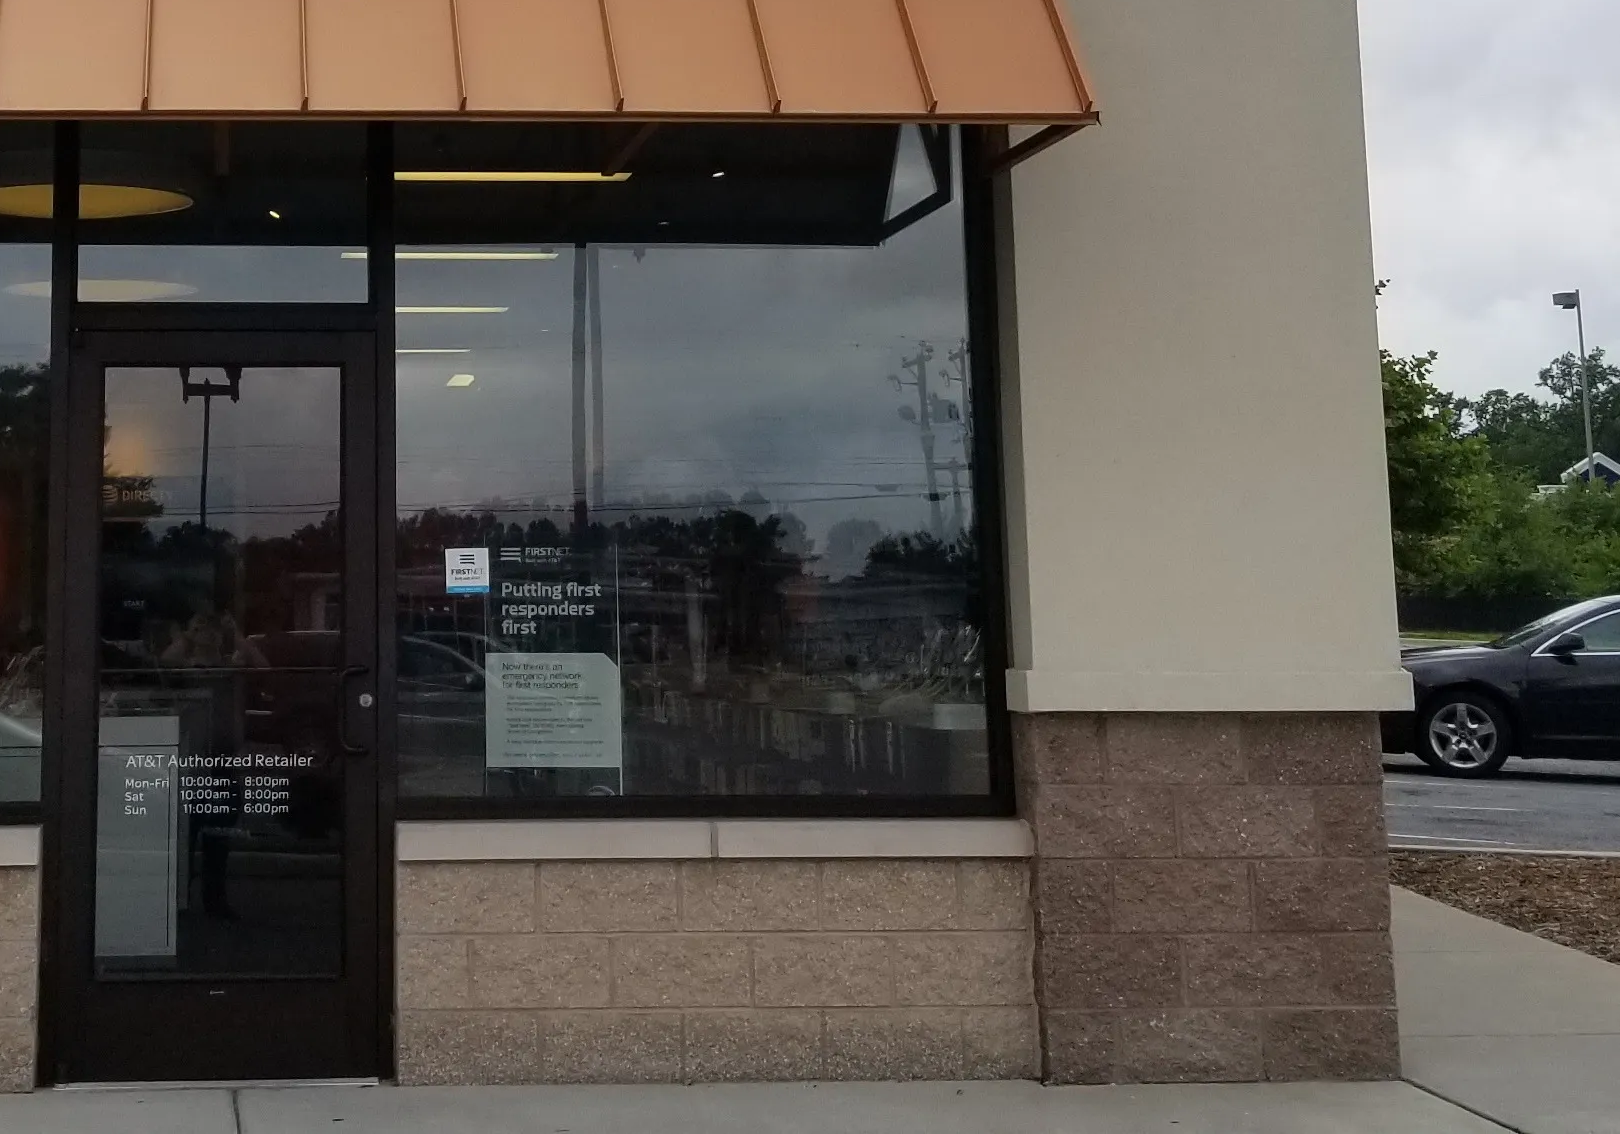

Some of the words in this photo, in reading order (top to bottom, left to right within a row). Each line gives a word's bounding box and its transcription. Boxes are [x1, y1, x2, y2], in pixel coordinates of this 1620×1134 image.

[501, 582, 562, 600] Putting
[566, 582, 602, 597] first
[501, 600, 595, 618] responders
[501, 619, 537, 635] first
[125, 754, 165, 768] AT&T
[167, 754, 252, 768] Authorized
[255, 754, 314, 768] Retailer
[124, 778, 170, 789] Mon-Fri
[180, 776, 230, 787] 10:00am
[244, 776, 290, 788] 8:00pm
[124, 791, 145, 802] Sat
[180, 790, 230, 800] 10:00am
[244, 790, 290, 801] 8:00pm
[124, 805, 147, 816] Sun
[183, 803, 230, 814] 11:00am
[243, 803, 289, 815] 6:00pm
